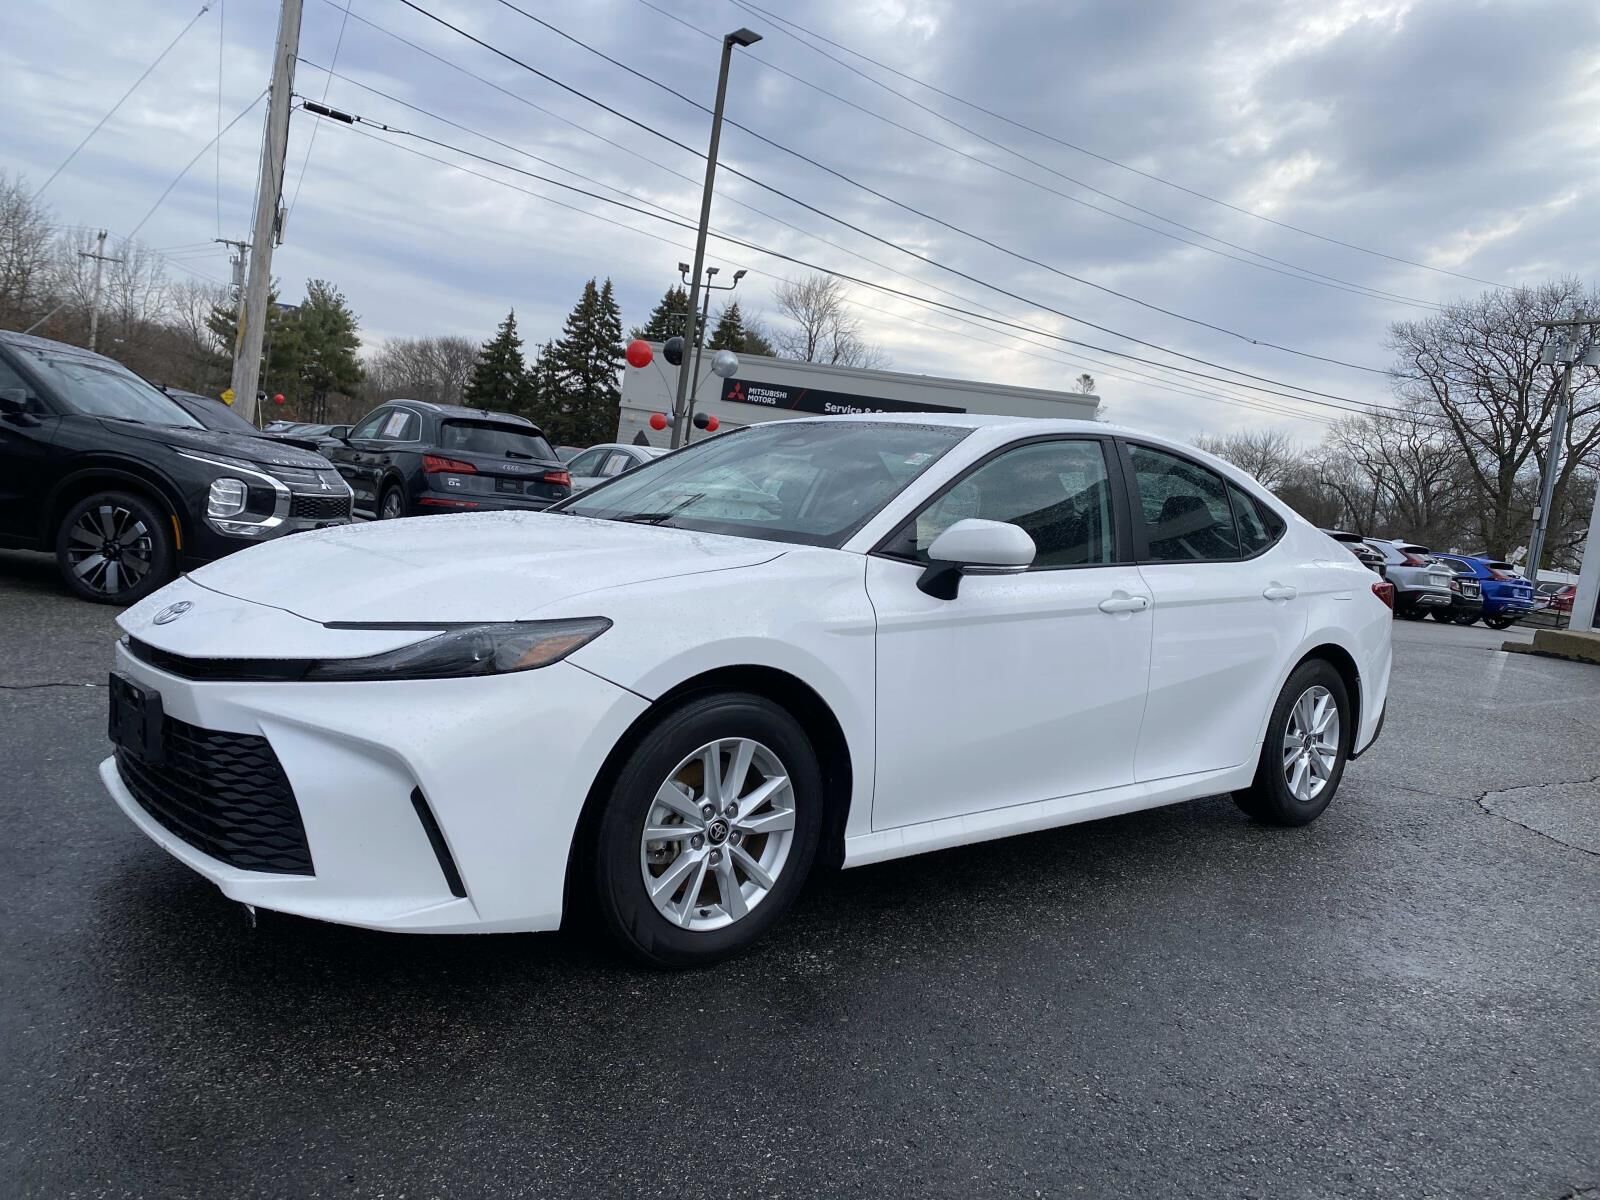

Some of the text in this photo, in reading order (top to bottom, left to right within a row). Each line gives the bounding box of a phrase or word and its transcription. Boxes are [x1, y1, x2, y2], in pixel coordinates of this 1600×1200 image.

[748, 387, 788, 399] MITSUBISHI
[747, 394, 777, 405] MOTORS
[824, 402, 862, 414] Service
